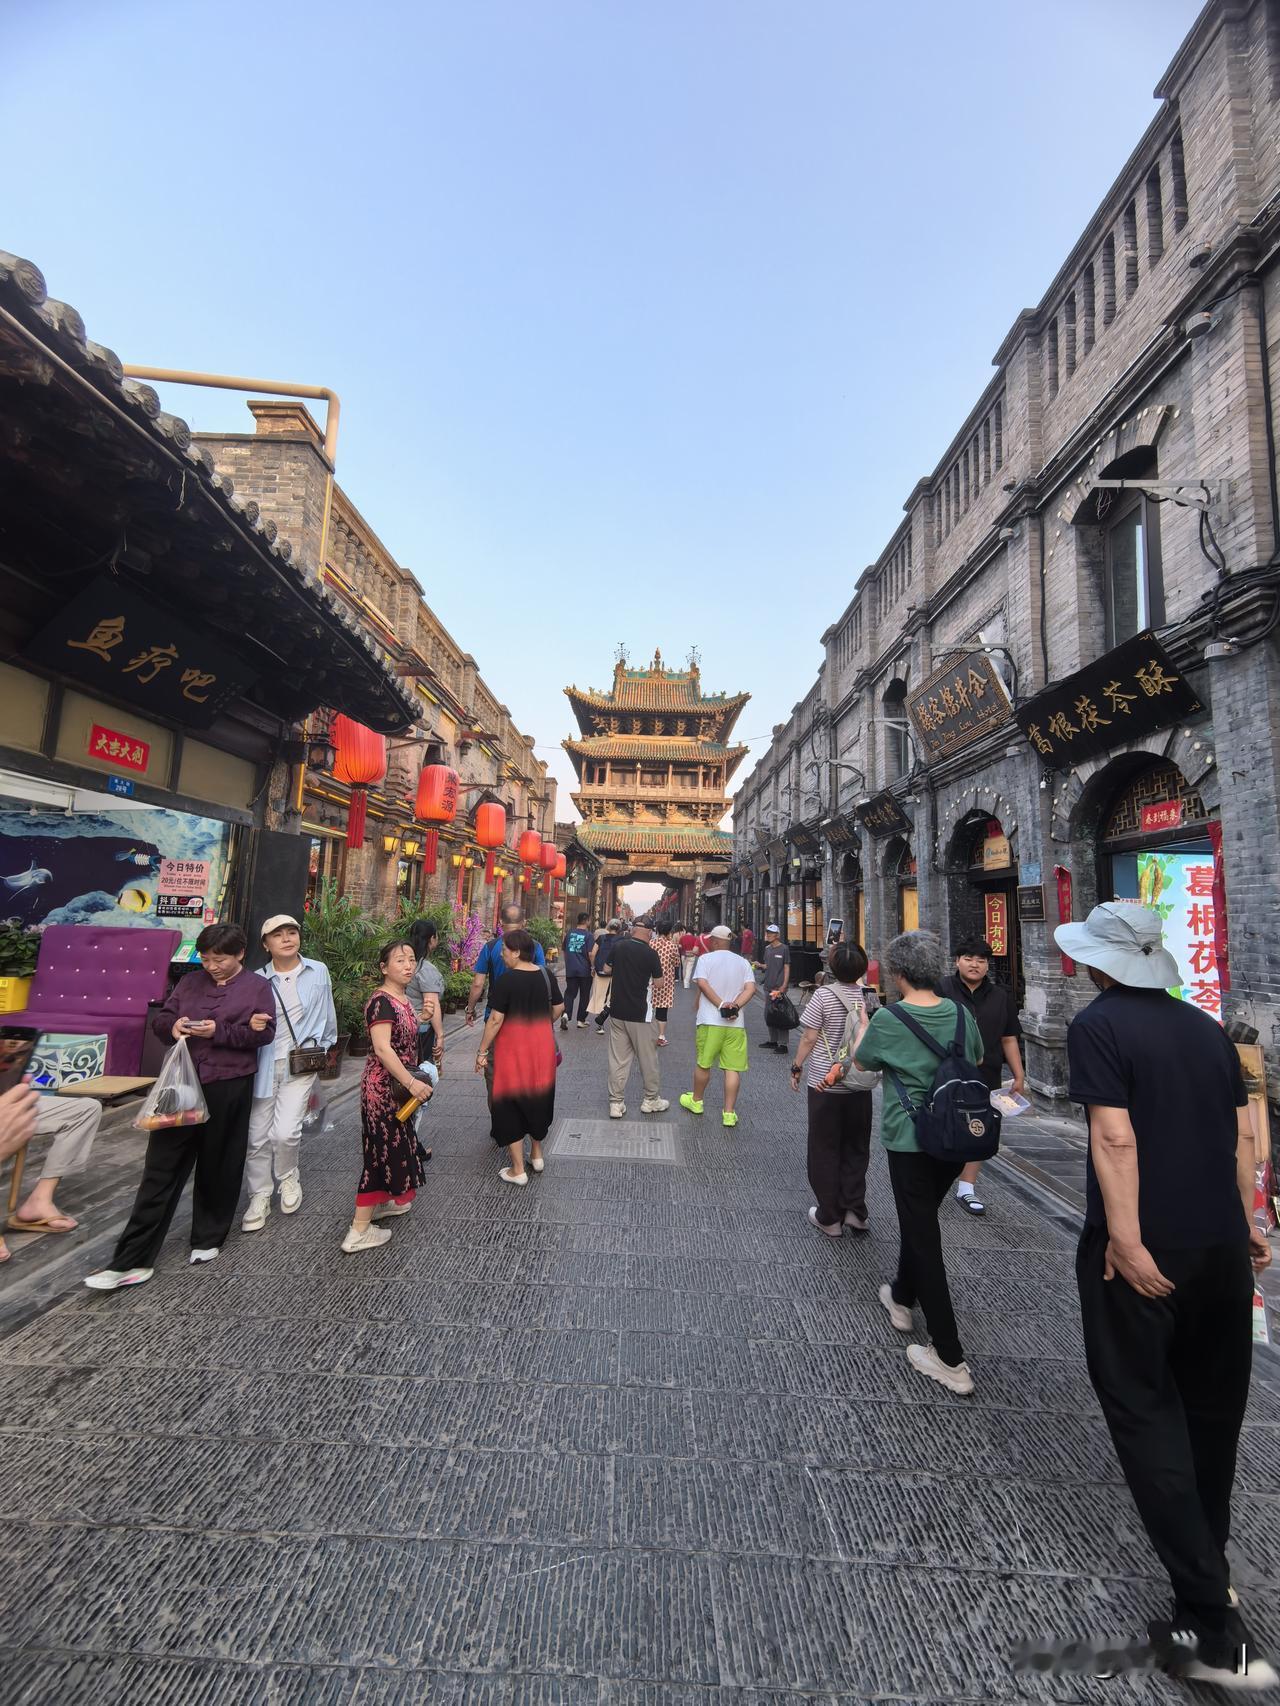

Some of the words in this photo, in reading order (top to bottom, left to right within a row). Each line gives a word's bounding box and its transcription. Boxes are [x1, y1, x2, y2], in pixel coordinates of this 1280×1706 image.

[66, 616, 217, 703] 鱼疗吧
[976, 702, 1001, 720] Hotel
[95, 733, 144, 765] 大吉大利
[166, 861, 204, 873] 今日特价
[988, 897, 1004, 952] 今日有房
